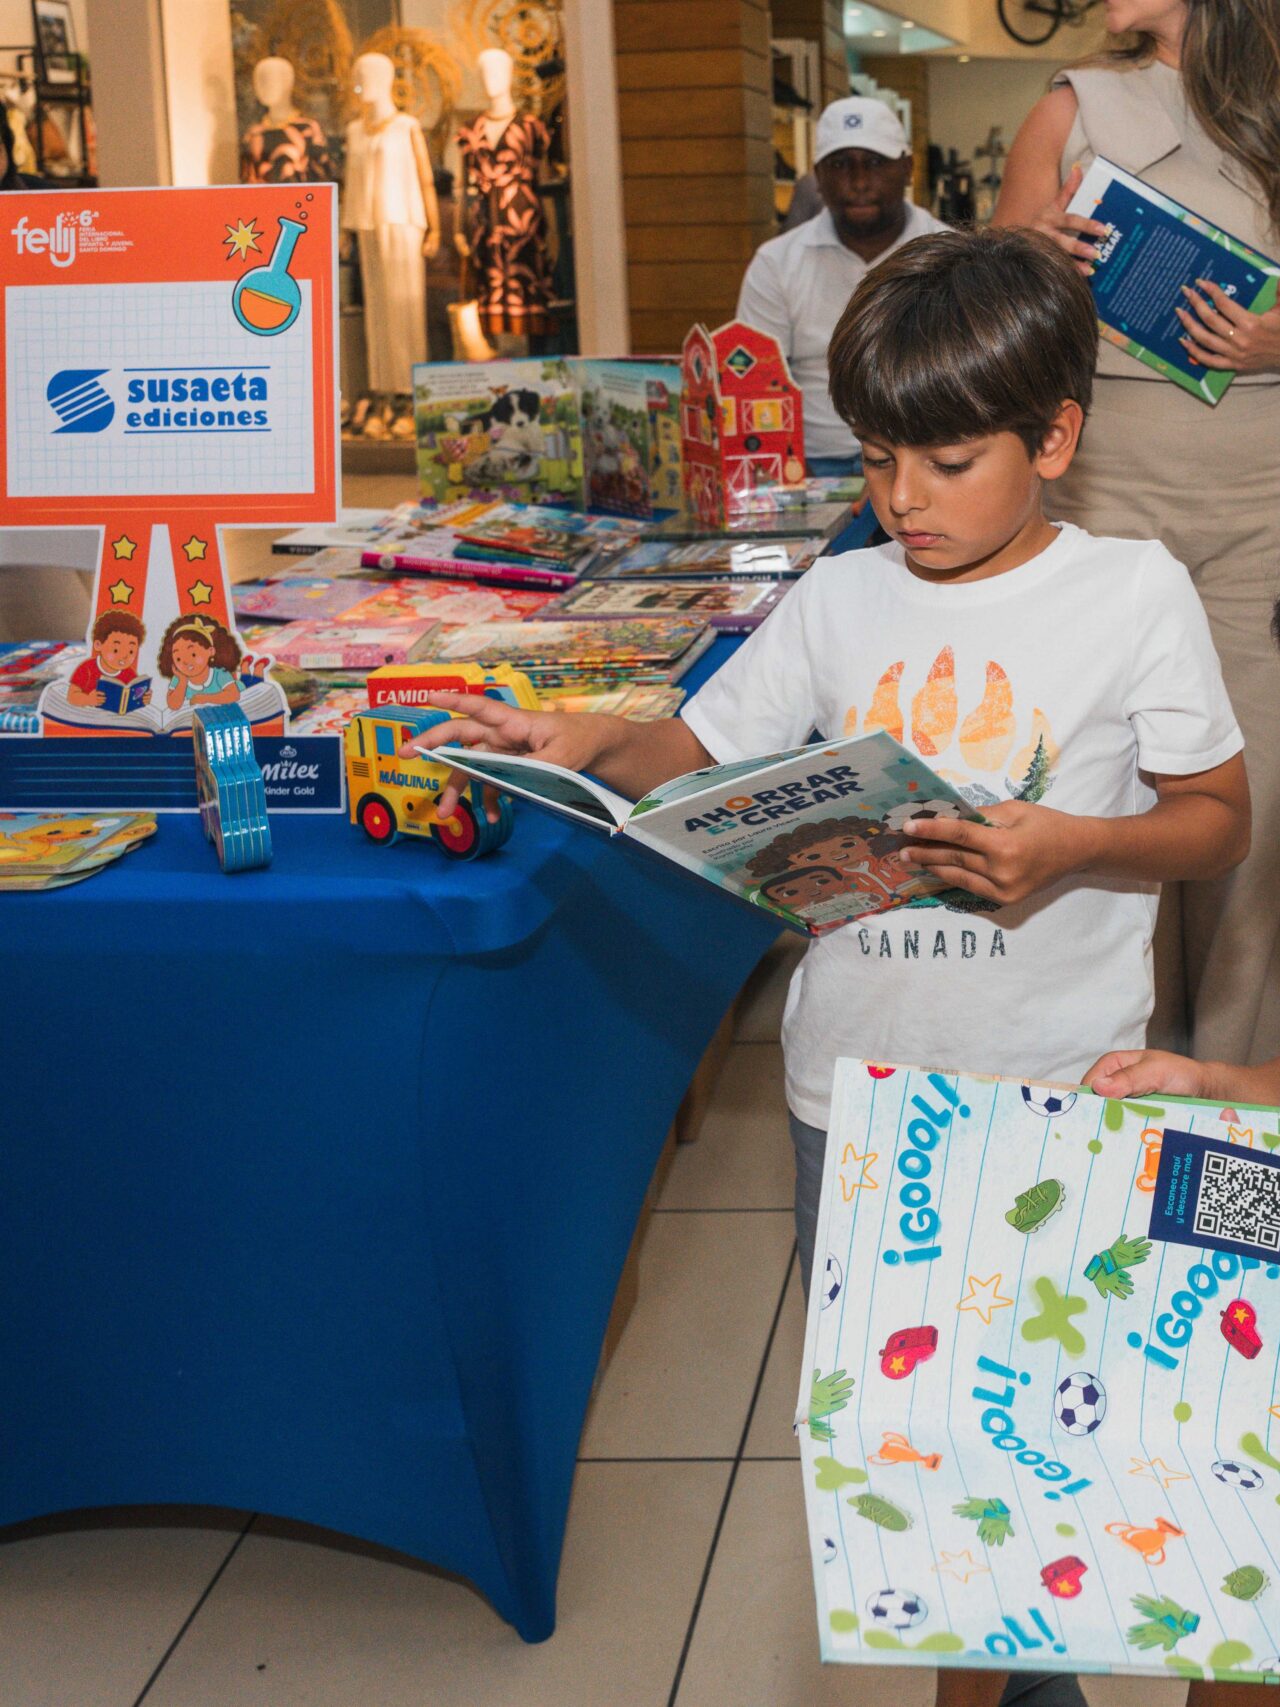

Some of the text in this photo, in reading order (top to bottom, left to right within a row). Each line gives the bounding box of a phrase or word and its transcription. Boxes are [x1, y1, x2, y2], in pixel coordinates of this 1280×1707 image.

[127, 372, 269, 403] susaeta
[126, 408, 269, 428] ediciones
[376, 688, 460, 704] CAMIO
[261, 760, 319, 781] Milex
[379, 769, 440, 792] MÁQUINAS
[293, 786, 315, 796] Gold
[684, 765, 860, 832] AHORRAR
[705, 781, 865, 836] ES CREAR
[858, 928, 1006, 959] CANADA
[1164, 1154, 1182, 1216] Escanea aquí
[1176, 1174, 1190, 1216] descubre
[1184, 1152, 1193, 1172] más
